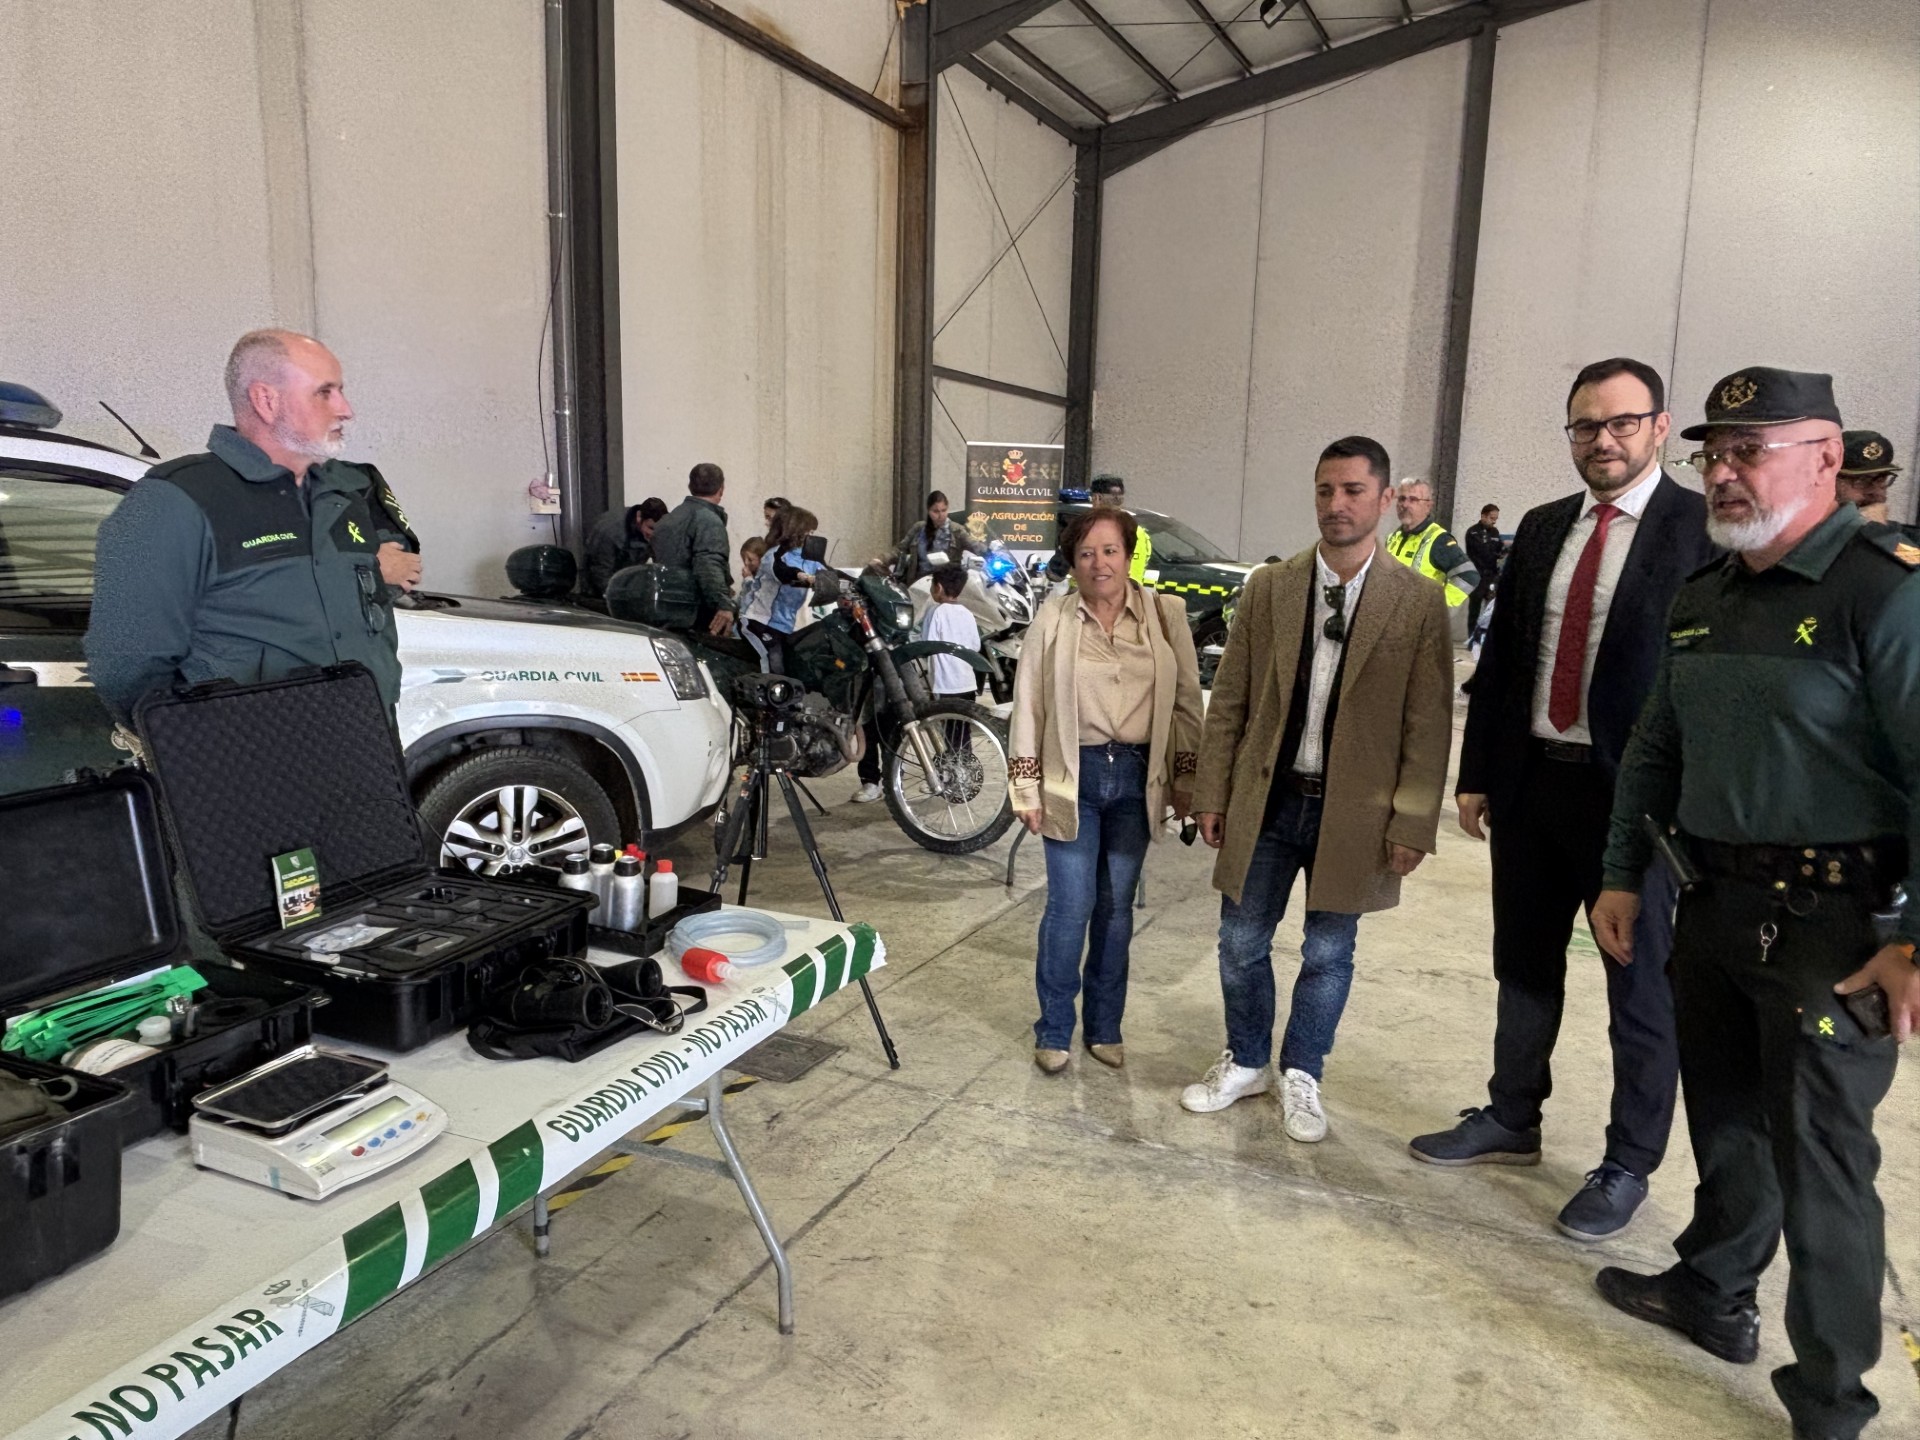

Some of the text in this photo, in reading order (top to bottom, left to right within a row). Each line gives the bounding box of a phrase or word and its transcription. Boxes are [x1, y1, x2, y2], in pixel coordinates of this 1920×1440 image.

[977, 486, 1053, 496] GUARDIA CIVIL
[991, 511, 1055, 521] AGRUPACIÓN
[1013, 523, 1027, 531] DE
[242, 534, 281, 548] GUARDIA
[1002, 532, 1043, 542] TRÁFICO
[482, 670, 604, 683] GUARDIA CIVIL
[546, 1078, 649, 1143] GUARDIA
[631, 1050, 689, 1088] CIVIL
[681, 1028, 722, 1057] NO
[706, 999, 768, 1042] PASAR
[71, 1308, 284, 1440] NO PASAR
